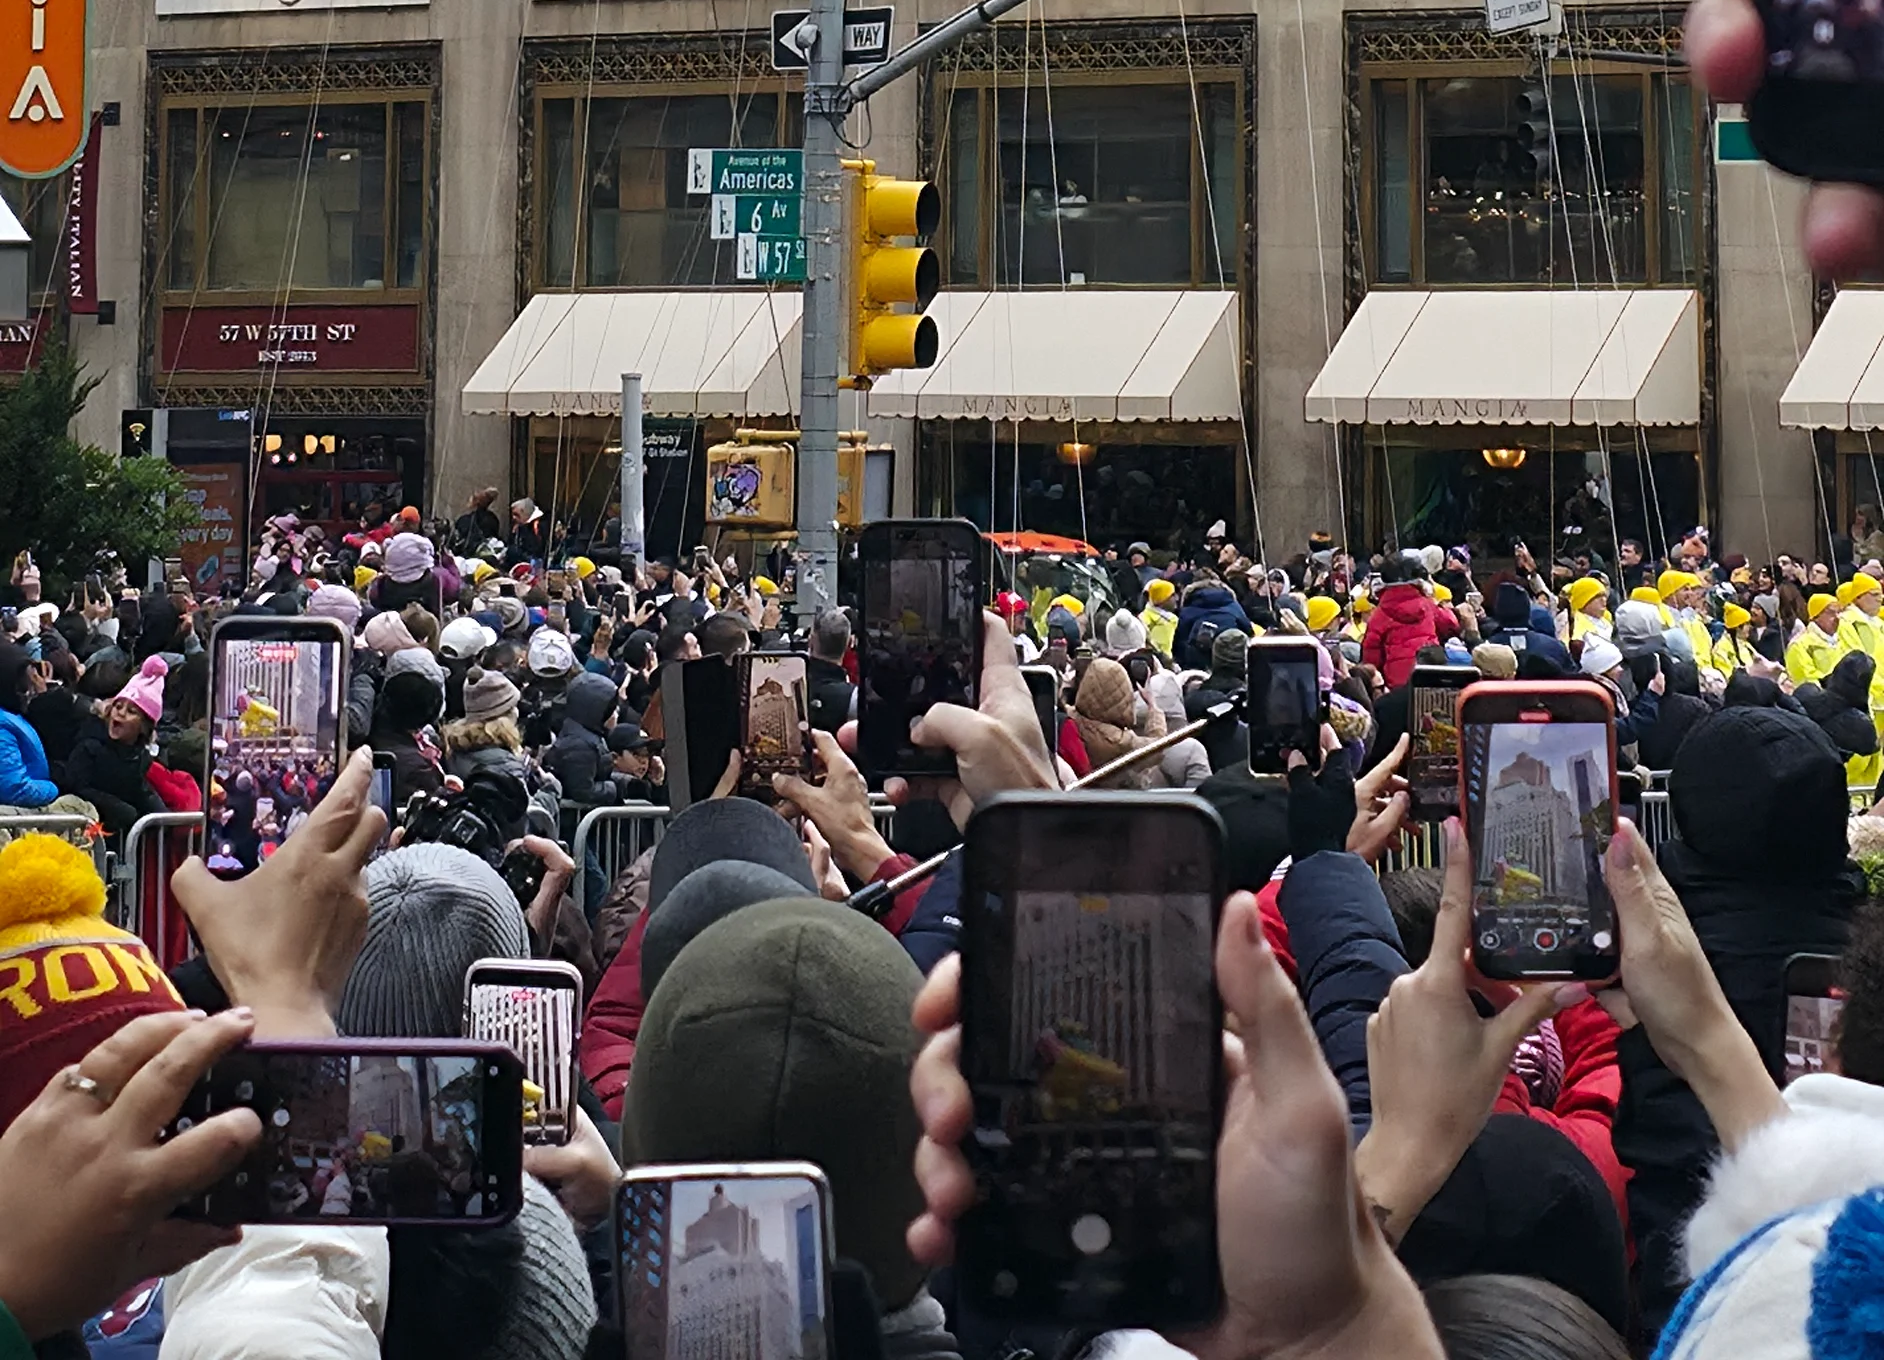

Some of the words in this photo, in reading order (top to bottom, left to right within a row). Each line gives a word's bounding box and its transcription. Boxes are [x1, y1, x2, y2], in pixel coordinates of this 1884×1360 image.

[853, 25, 880, 48] WAY
[71, 153, 84, 207] LITY
[720, 168, 794, 189] Americas
[751, 202, 762, 233] 6
[772, 200, 787, 218] Av
[69, 215, 84, 298] ITALIAN
[758, 241, 769, 273] W
[775, 241, 791, 274] 57
[219, 325, 239, 341] 57
[245, 325, 262, 341] W
[267, 324, 317, 341] 57TH
[326, 324, 356, 341] ST
[962, 396, 1072, 415] MANGIA
[1407, 400, 1527, 417] MANGIA
[643, 433, 680, 449] ubway
